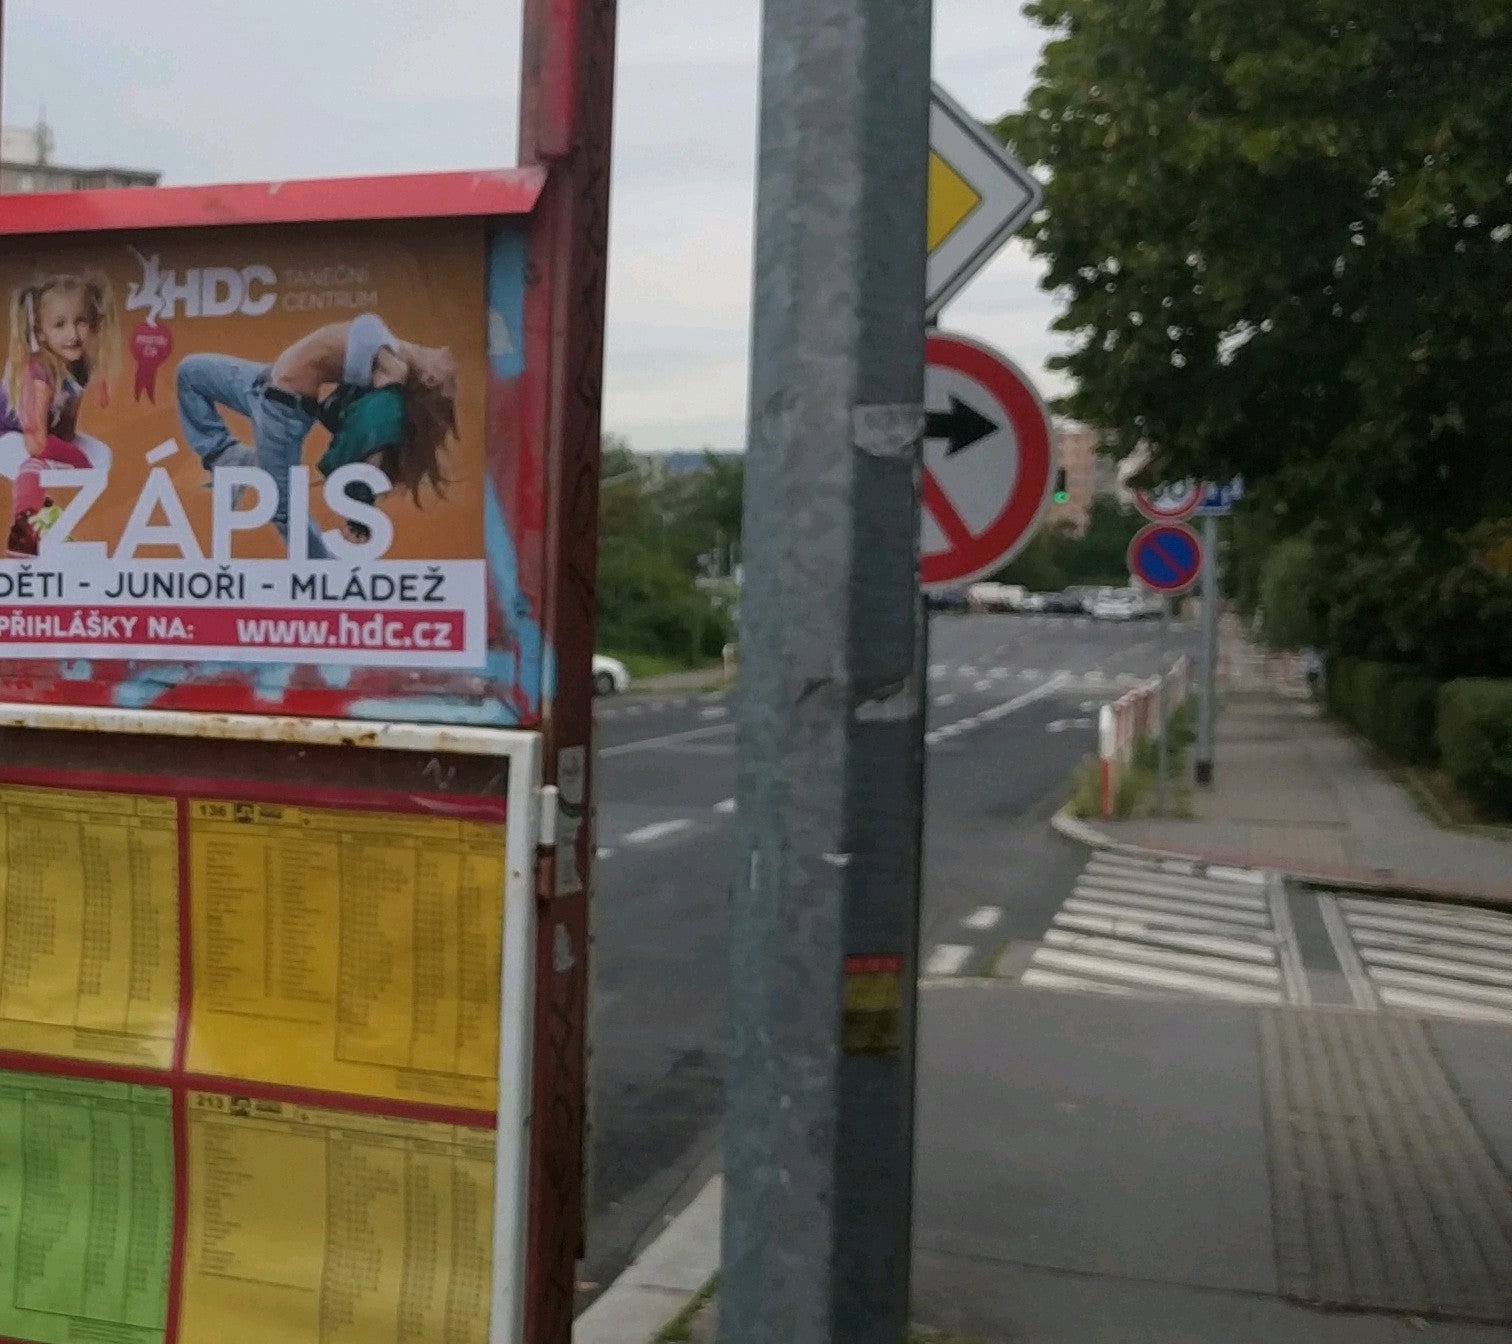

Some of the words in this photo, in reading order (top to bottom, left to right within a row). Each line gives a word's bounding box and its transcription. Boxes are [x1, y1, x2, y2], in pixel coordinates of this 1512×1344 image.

[158, 264, 277, 318] HDC
[282, 291, 378, 313] CENTRUM
[38, 439, 395, 561] ZÁPIS
[105, 565, 245, 601] JUNIOŘI
[291, 567, 445, 603] MLÁDEŽ
[148, 616, 194, 639] NA:
[237, 612, 452, 649] www.hdc.cz
